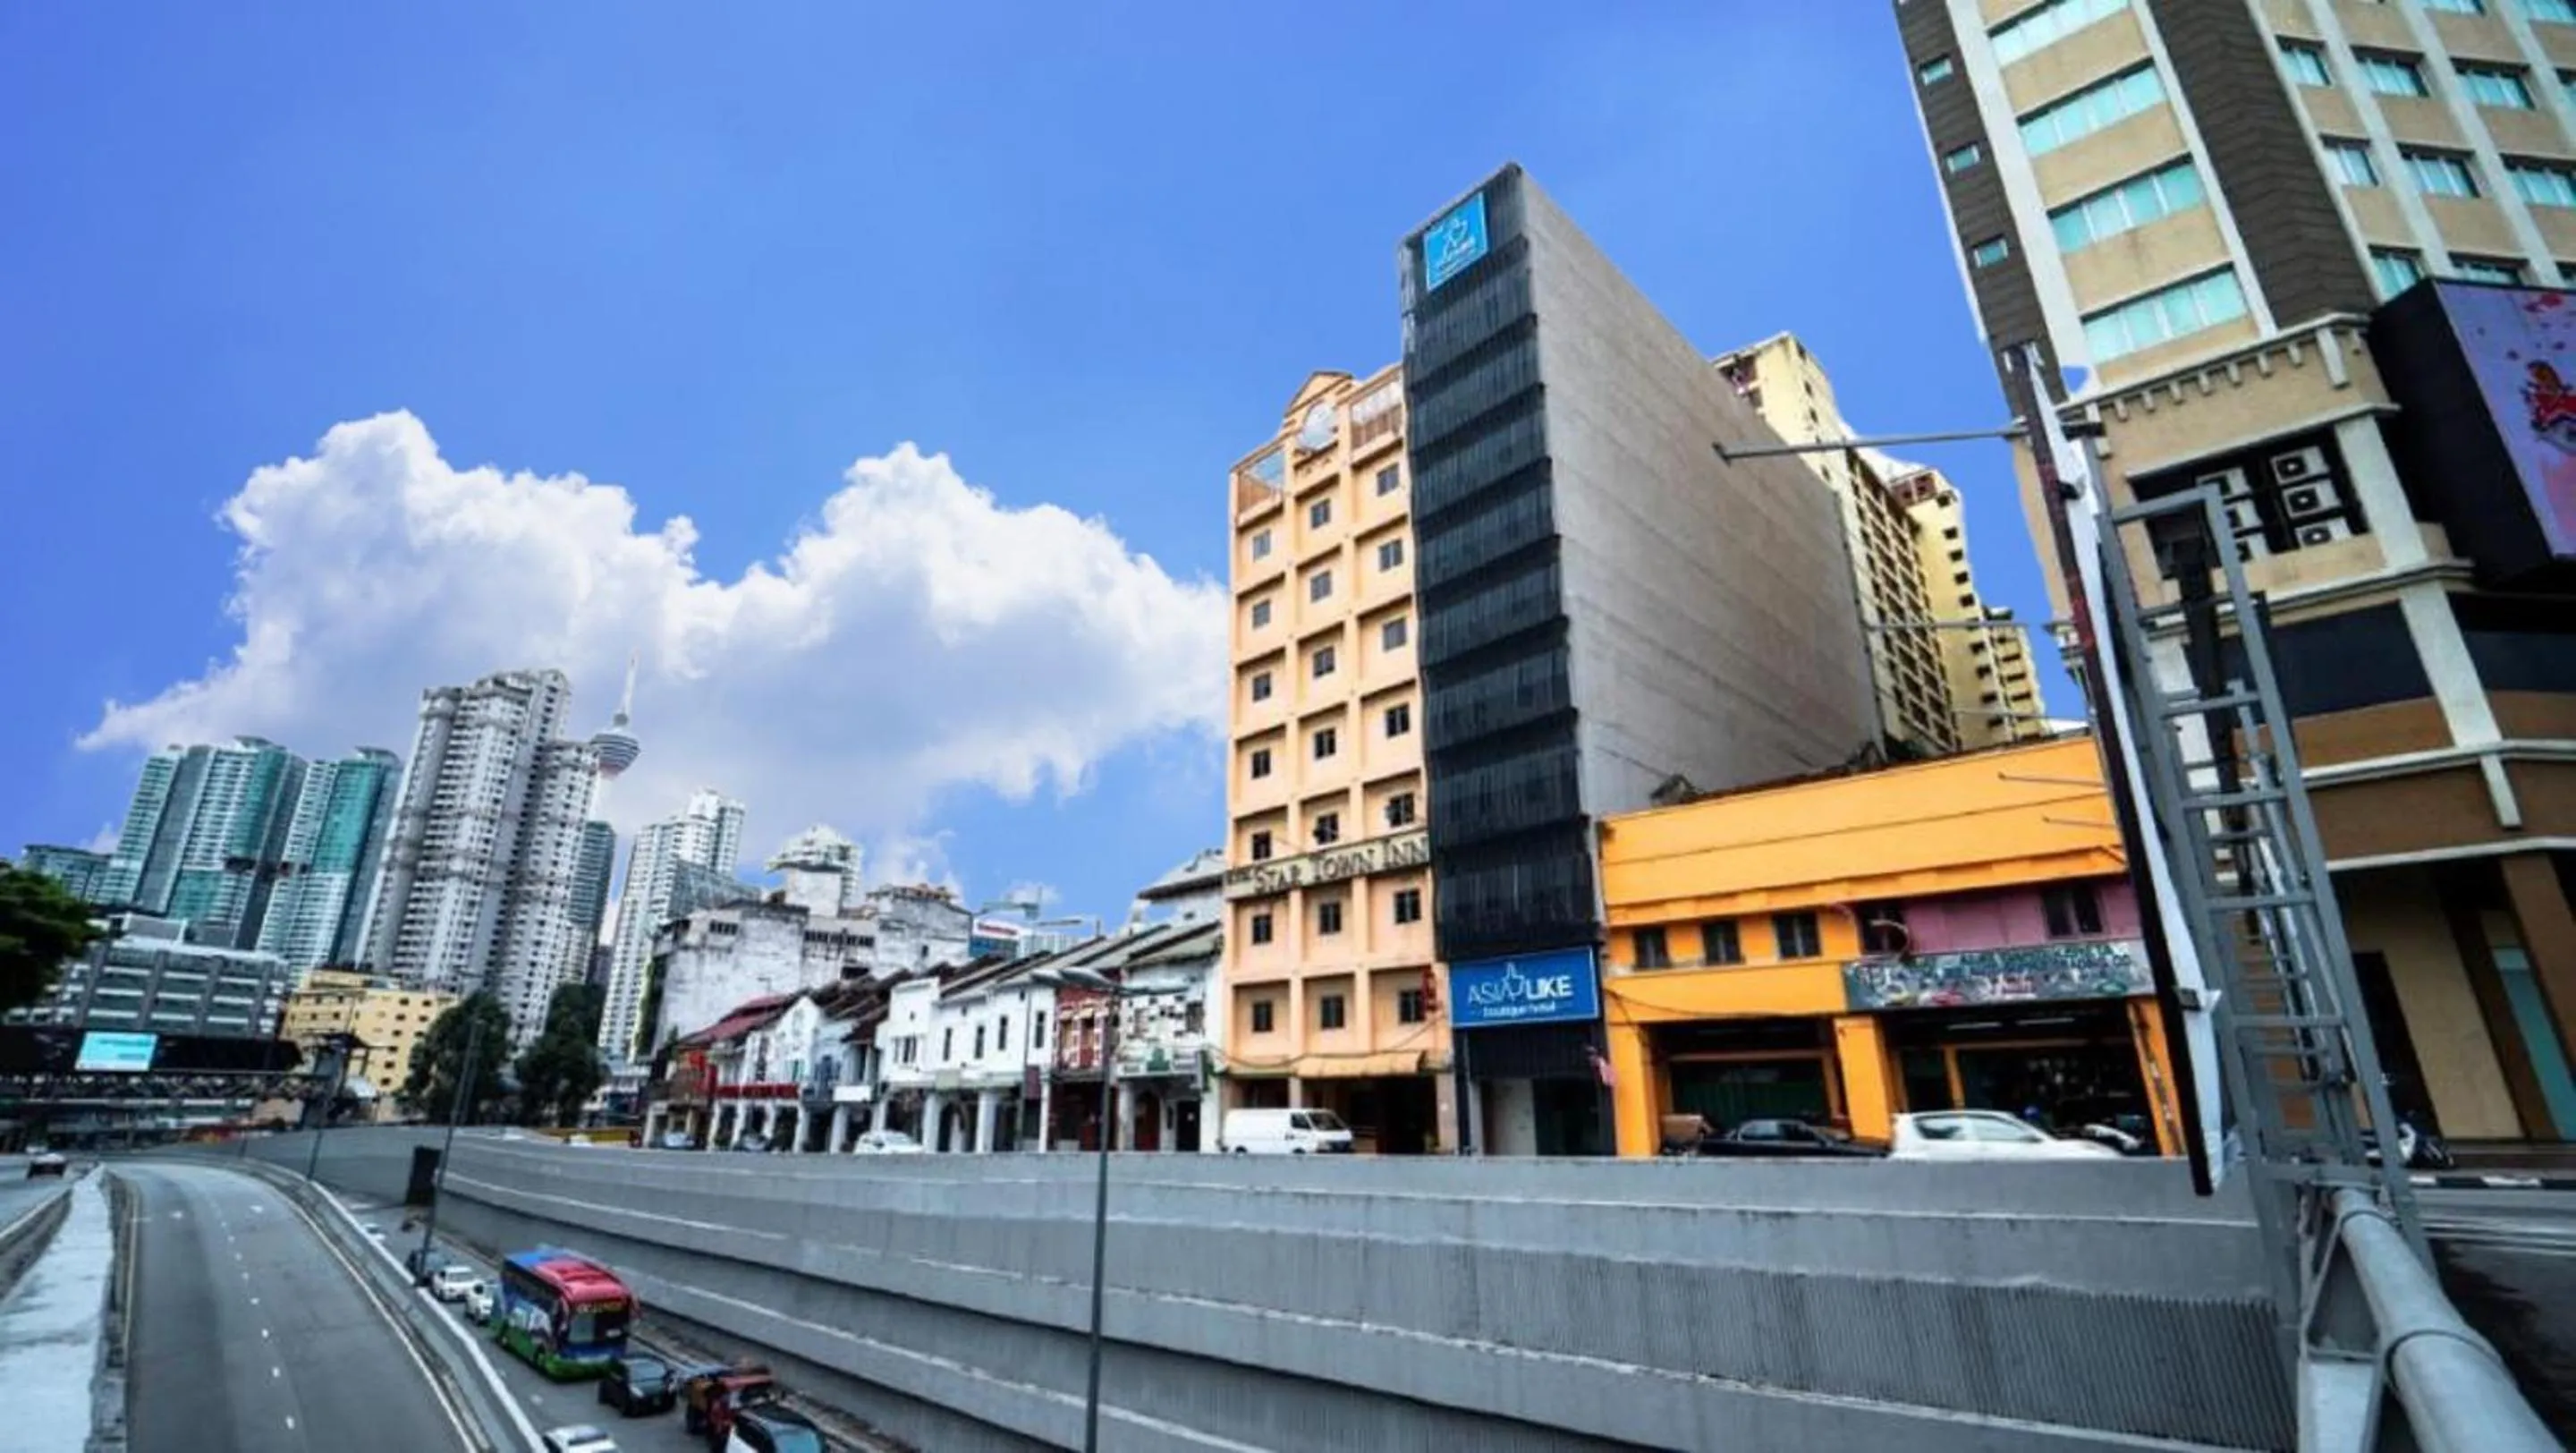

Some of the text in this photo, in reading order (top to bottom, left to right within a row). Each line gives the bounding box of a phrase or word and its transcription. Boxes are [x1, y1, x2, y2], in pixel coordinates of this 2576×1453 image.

[1254, 865, 1301, 893] STAR
[1312, 849, 1375, 881] TOWN
[1526, 975, 1573, 1000] LIKE
